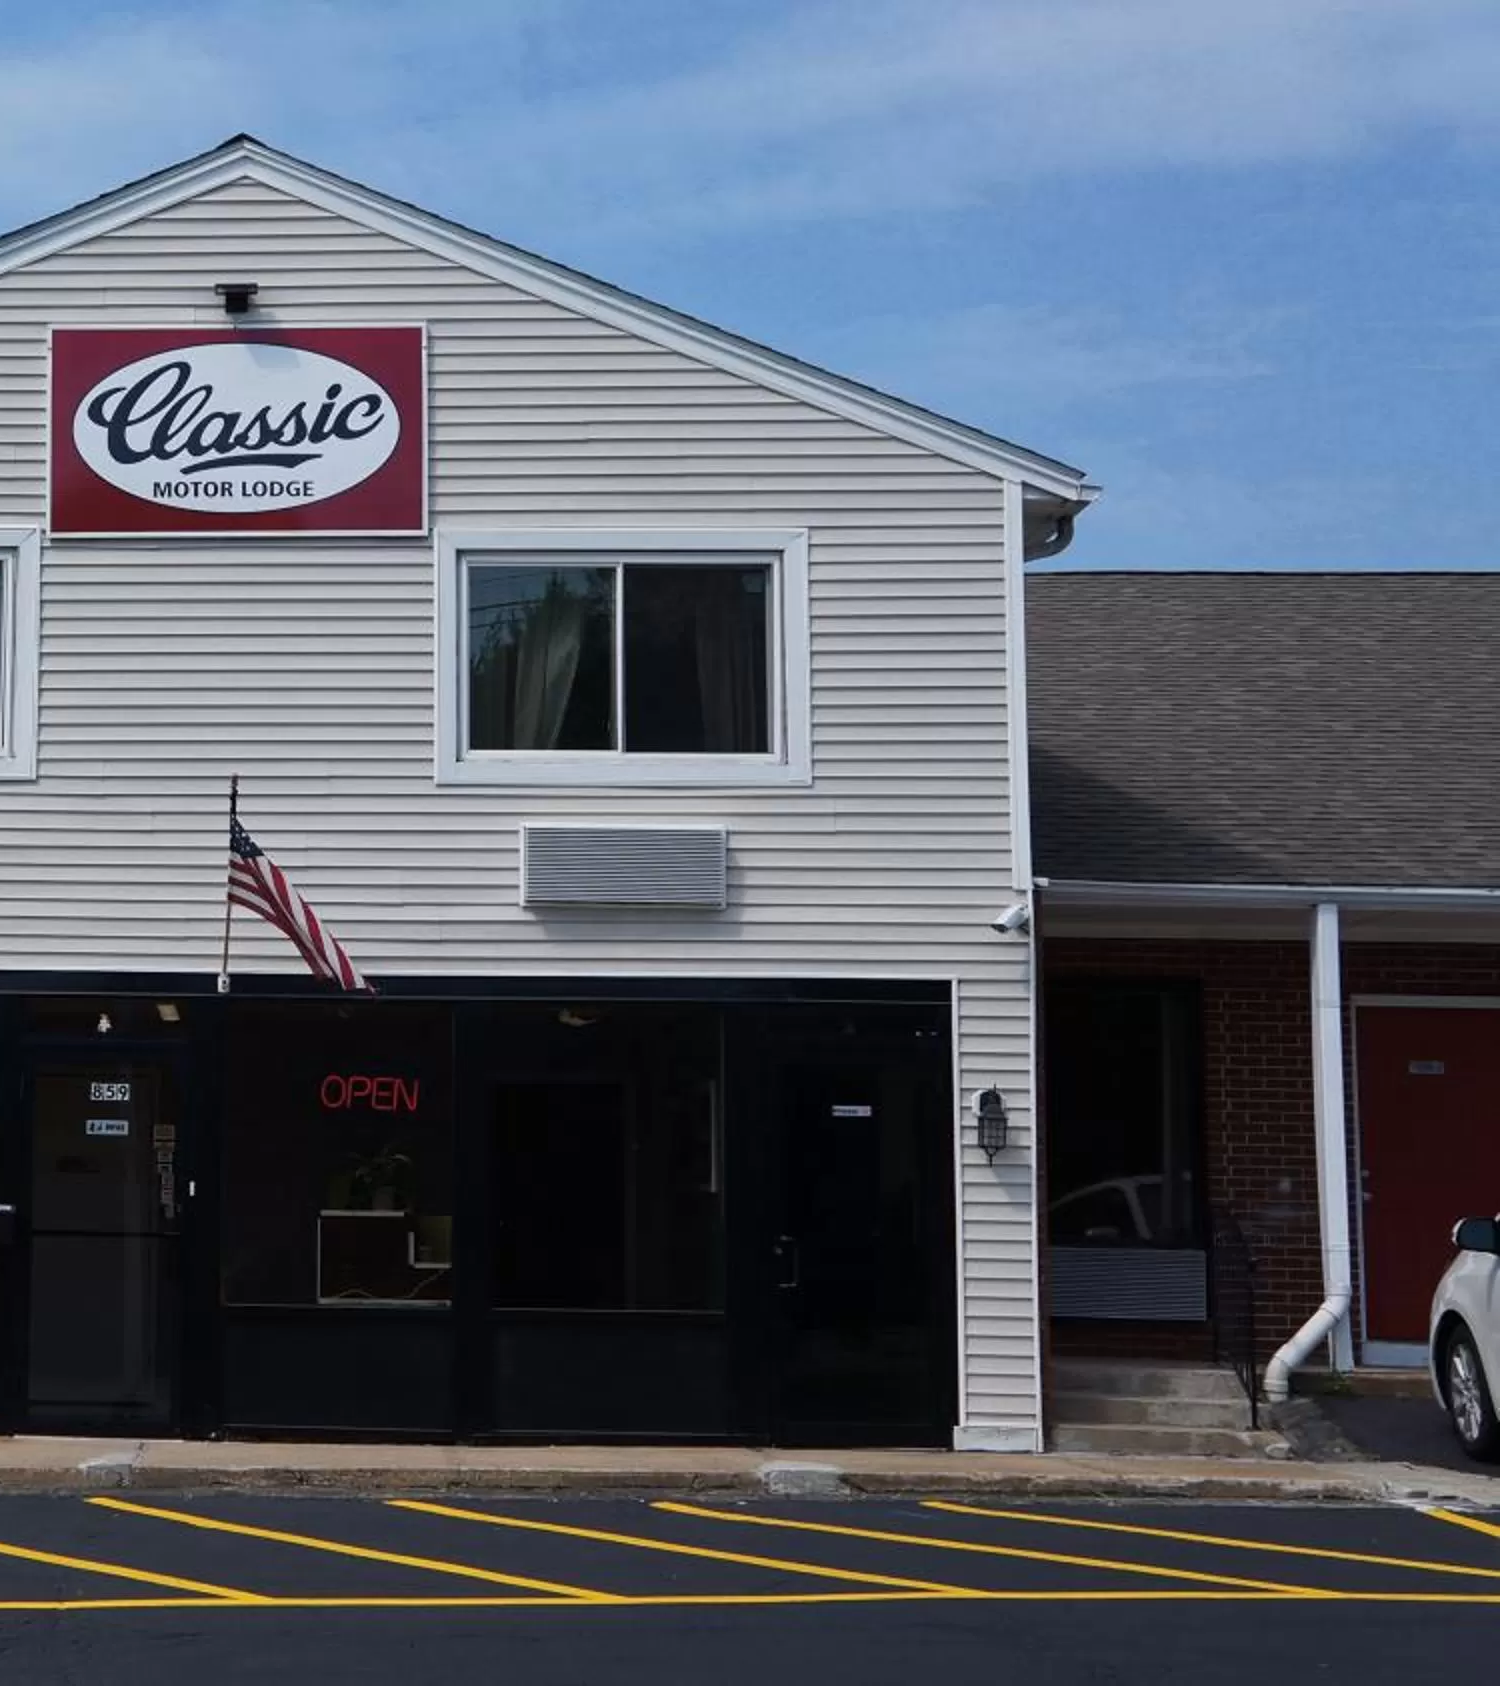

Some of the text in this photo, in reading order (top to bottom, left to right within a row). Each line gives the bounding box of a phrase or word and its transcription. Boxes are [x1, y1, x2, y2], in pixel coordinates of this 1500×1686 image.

[87, 361, 385, 464] Classic
[153, 481, 315, 498] MOTOR LODGE
[321, 1075, 419, 1111] OPEN
